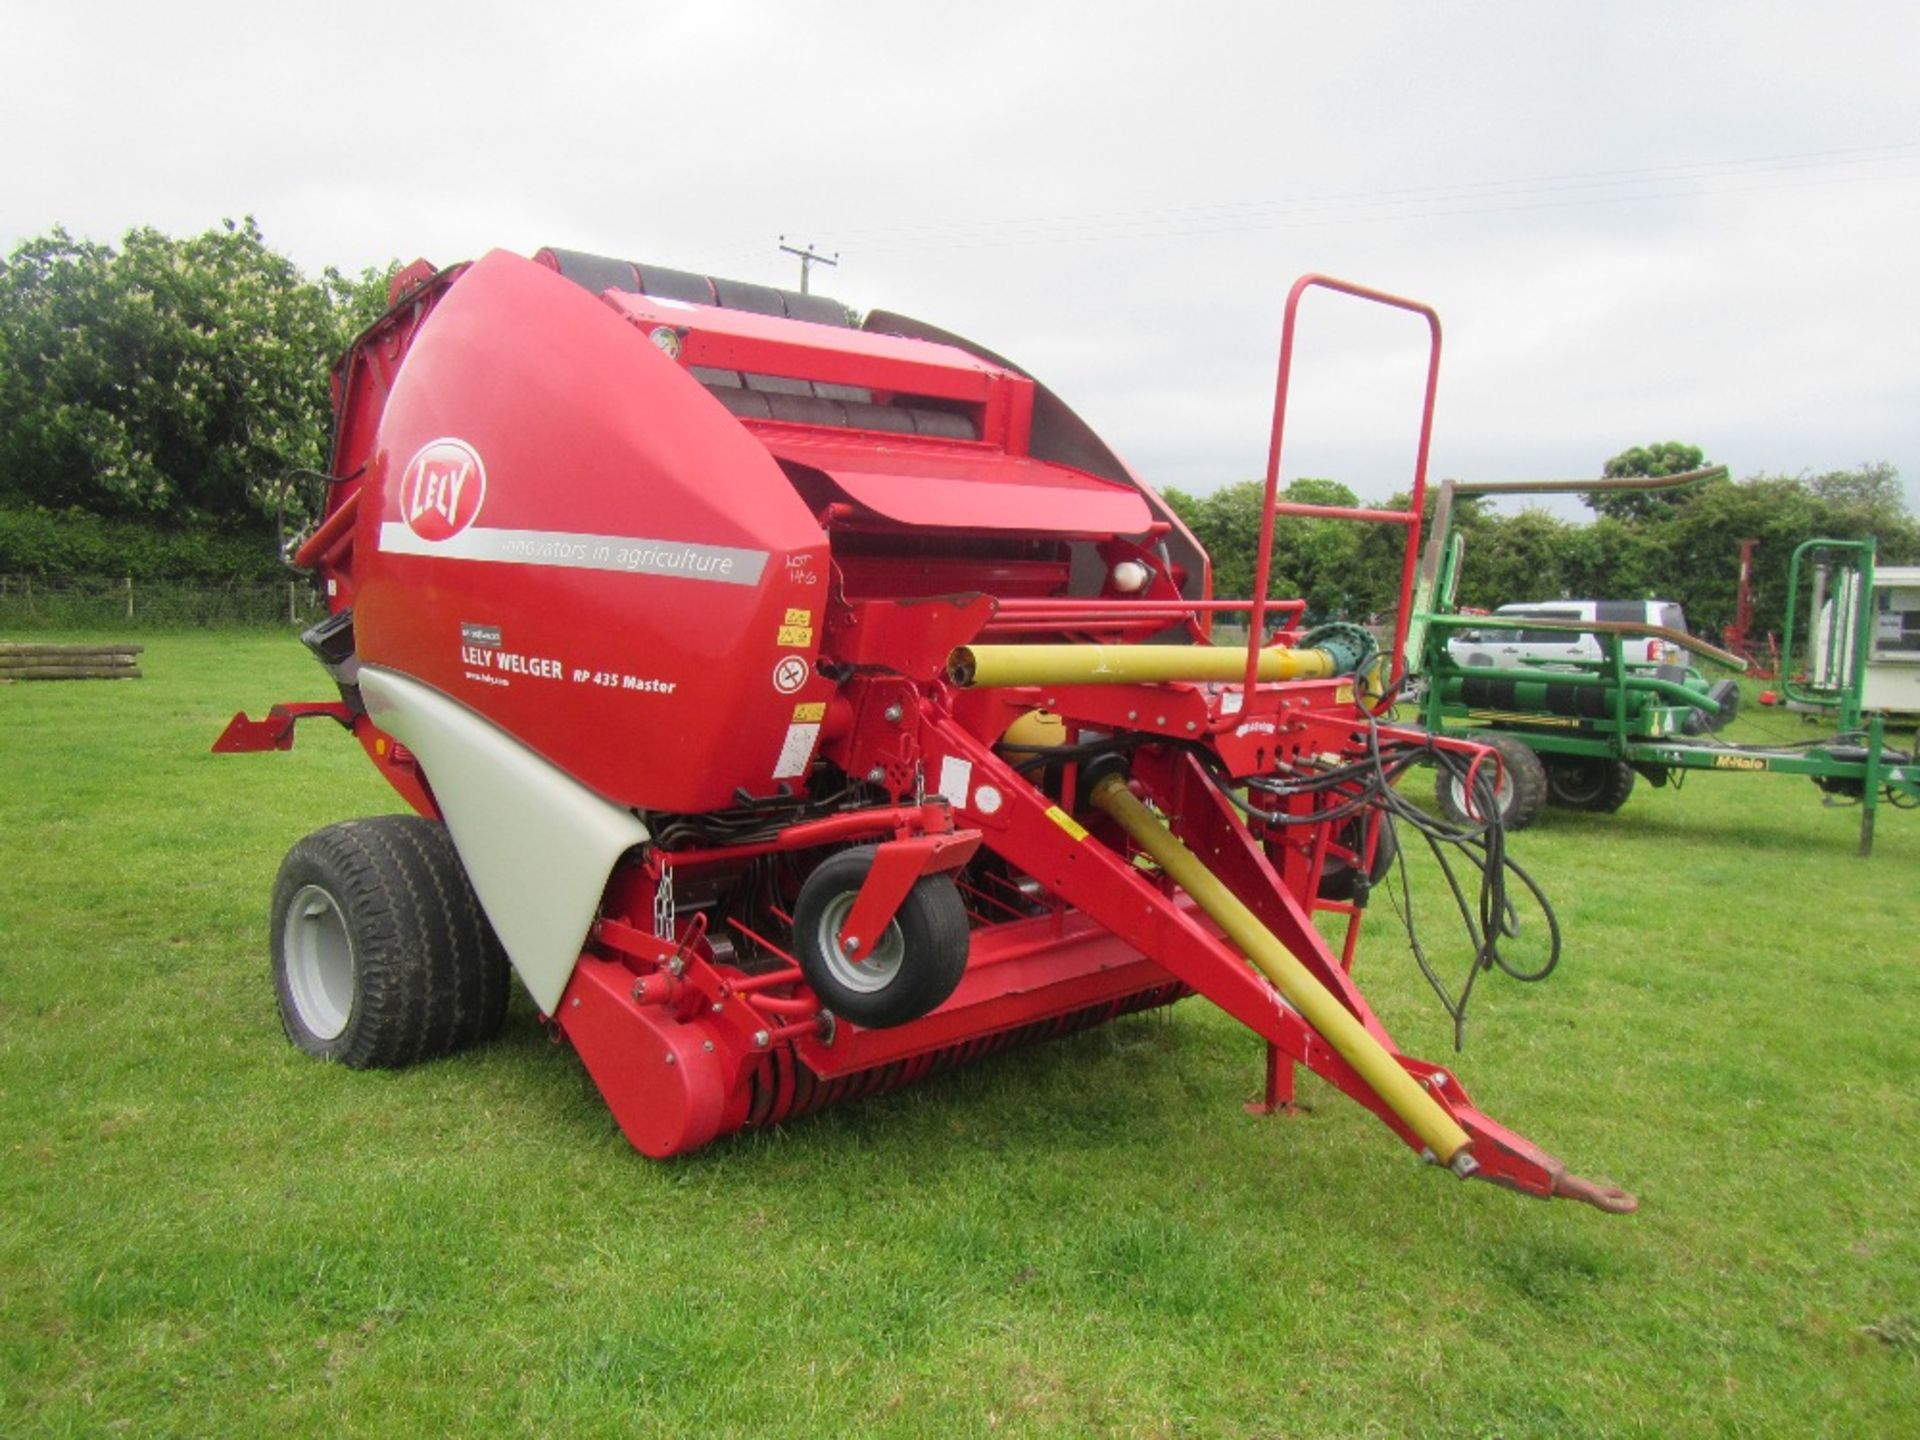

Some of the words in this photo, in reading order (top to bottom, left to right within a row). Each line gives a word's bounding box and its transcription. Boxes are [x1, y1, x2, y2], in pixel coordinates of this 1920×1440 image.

[410, 459, 471, 526] LELY
[502, 540, 588, 559] innovators
[592, 542, 609, 561] in
[617, 545, 735, 575] agriculture
[785, 554, 813, 569] LOT
[461, 645, 492, 667] LELY
[496, 652, 563, 680] WELGER
[573, 669, 591, 683] RP
[593, 672, 618, 687] 435
[622, 675, 677, 693] Master
